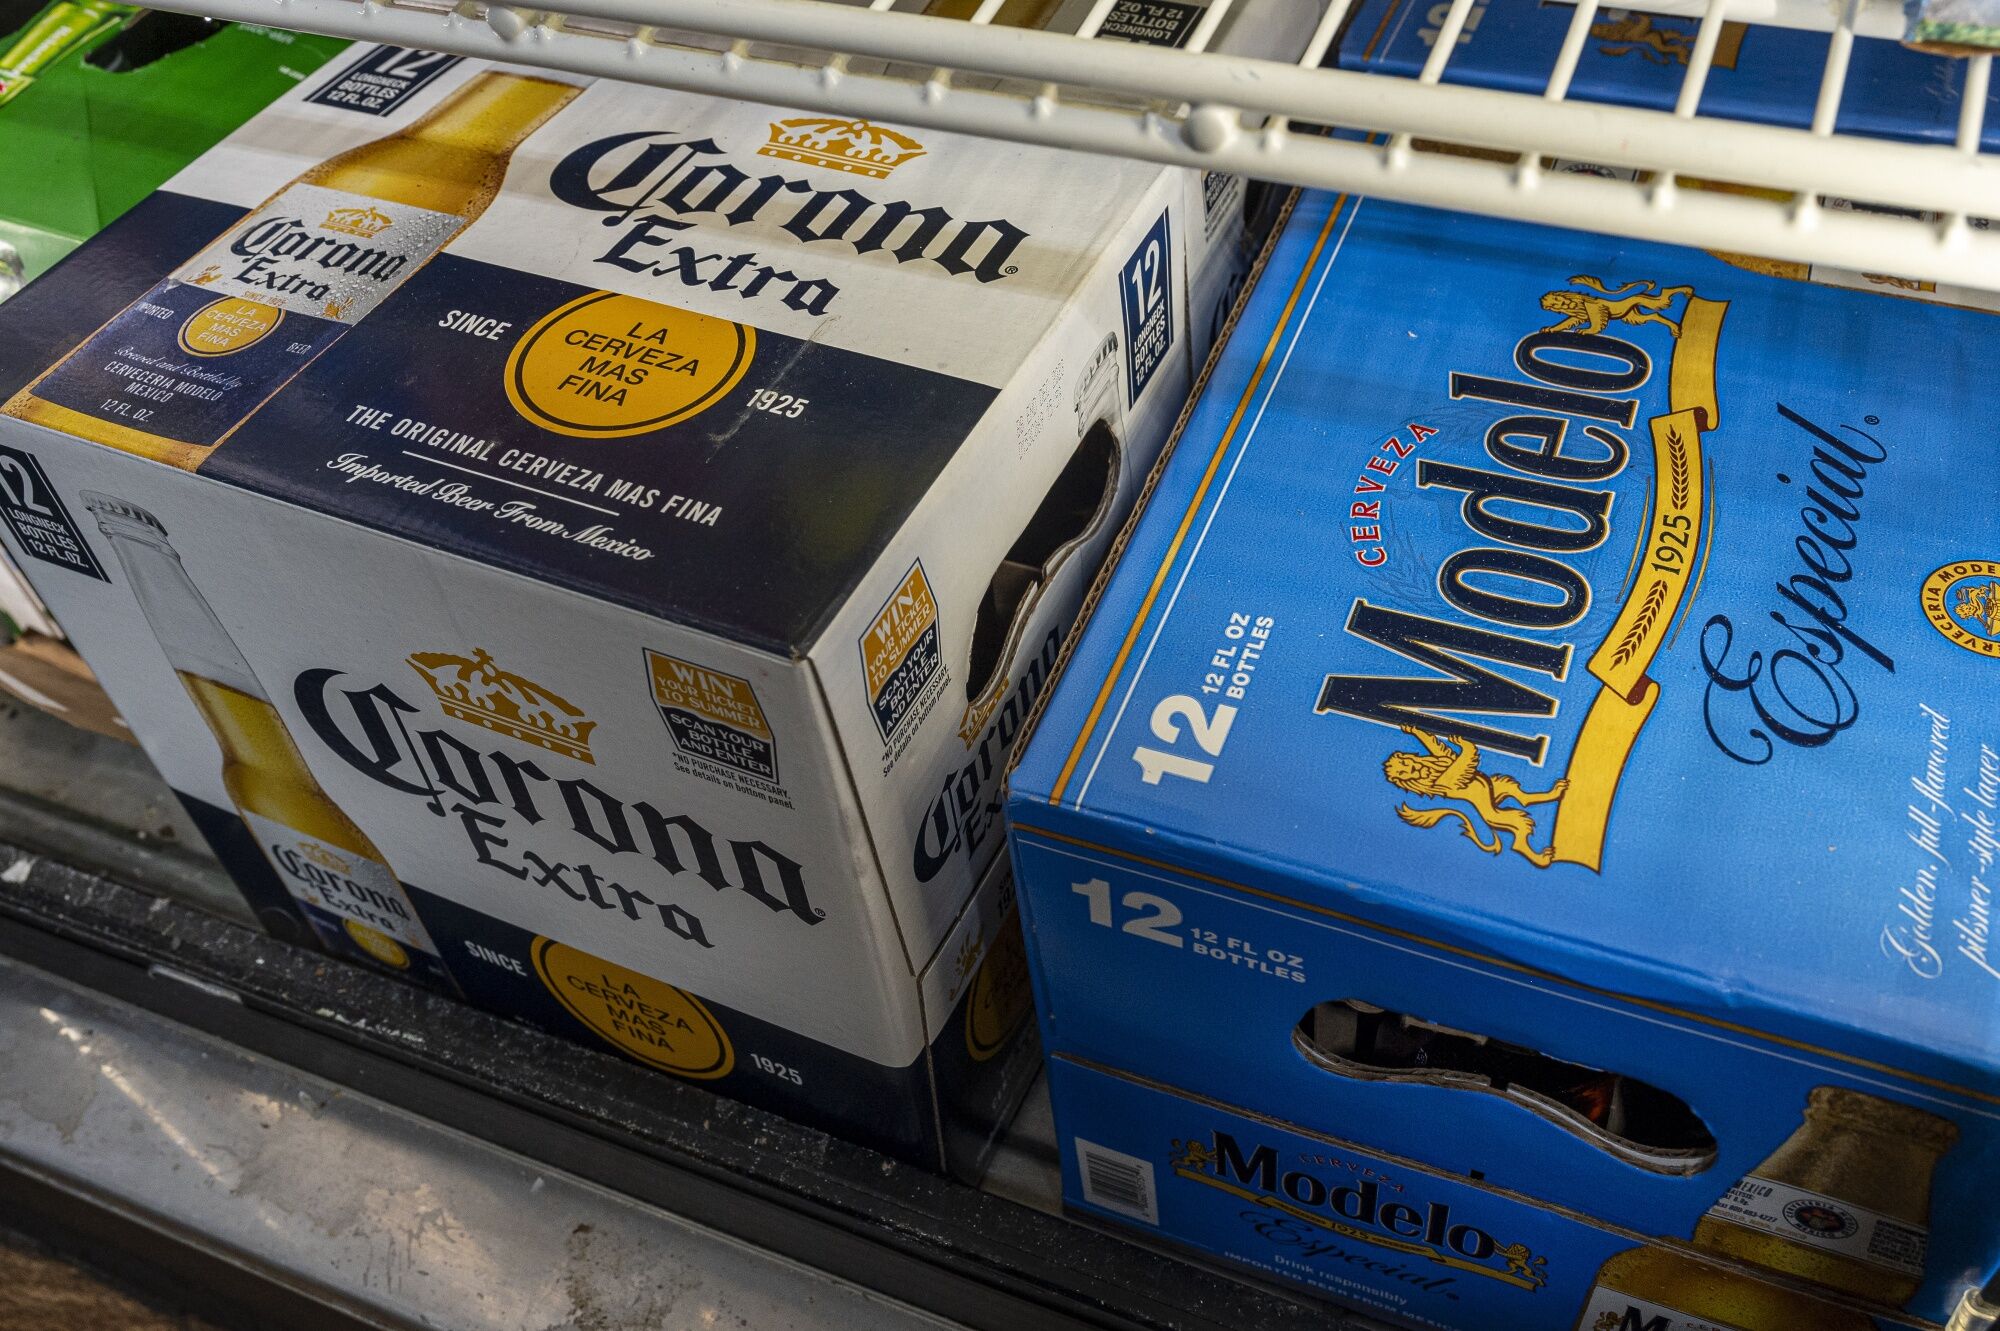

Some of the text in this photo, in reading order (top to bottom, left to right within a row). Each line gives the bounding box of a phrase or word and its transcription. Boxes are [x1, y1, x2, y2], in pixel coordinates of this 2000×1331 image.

[1102, 21, 1172, 40] LONGNECK
[1108, 11, 1179, 30] BOTTLES
[1166, 8, 1184, 19] 12
[326, 90, 346, 100] 12
[338, 80, 400, 100] BOTTLES
[351, 72, 411, 90] LONGNECK
[550, 131, 1030, 283] Corona
[231, 217, 408, 282] Corona
[593, 215, 840, 317] Extra
[233, 256, 331, 300] Extra
[1132, 239, 1162, 326] 12
[206, 309, 267, 331] CERVEZA
[210, 323, 242, 337] MAS
[236, 305, 257, 317] LA
[439, 309, 512, 341] SINCE
[1134, 299, 1165, 353] LONGNECK
[197, 332, 230, 347] FINA
[563, 329, 700, 377] CERVEZA
[626, 321, 668, 344] LA
[1135, 316, 1166, 371] BOTTLES
[104, 361, 224, 401] CERVECERIA MODELO
[124, 381, 174, 403] MEXICO
[557, 375, 630, 407] FINA
[577, 355, 650, 387] MAS
[1135, 368, 1145, 387] 12
[100, 399, 154, 423] 12 FL. OZ.
[745, 388, 810, 420] 1925
[345, 404, 724, 528] THE ORIGINAL CERVEZA MAS FINA
[326, 452, 655, 563] Imported Beer From Mexico
[1350, 422, 1440, 568] CERVEZA
[8, 507, 69, 536] LONGNECK
[16, 521, 79, 552] BOTTLES
[28, 539, 46, 554] 12
[1313, 331, 1653, 768] Modelo
[1650, 514, 1694, 577] 1925
[1700, 401, 1896, 766] Especial
[868, 590, 928, 674] YOUR TICKET
[872, 603, 931, 687] TO SUMMER
[879, 629, 934, 711] SCAN YOUR
[1201, 612, 1251, 695] 12 FL OZ
[1225, 616, 1275, 700] BOTTLES
[658, 676, 756, 716] YOUR TICKET
[885, 652, 938, 733] AND ENTER
[890, 653, 928, 712] BOTTLE
[660, 687, 762, 729] TO SUMMER
[893, 703, 921, 750] PURCHASE
[670, 713, 765, 753] SCAN YOUR
[689, 730, 755, 759] BOTTLE
[883, 761, 895, 777] See
[893, 734, 912, 764] details
[918, 699, 938, 726] bottom
[1132, 694, 1238, 786] 12
[680, 737, 772, 775] AND ENTER
[293, 667, 823, 926] Corona
[673, 761, 691, 775] See
[692, 767, 721, 786] details
[723, 779, 735, 789] on
[735, 784, 767, 801] bottom
[692, 758, 739, 783] PURCHASE
[738, 774, 792, 800] NECESSARY.
[272, 844, 411, 921] Corona
[451, 802, 716, 948] Extra
[1071, 878, 1184, 949] 12
[464, 940, 528, 977] SINCE
[1190, 927, 1305, 969] 12 FL OZ
[1193, 942, 1307, 984] BOTTLES
[566, 975, 696, 1035] CERVEZA
[601, 974, 641, 999] LA
[606, 1003, 667, 1037] MAS
[610, 1019, 676, 1053] FINA
[750, 1053, 804, 1086] 1925
[1211, 1128, 1497, 1260] Modelo
[1238, 1211, 1456, 1298] Especial
[1275, 1254, 1407, 1306] Drink responsibly
